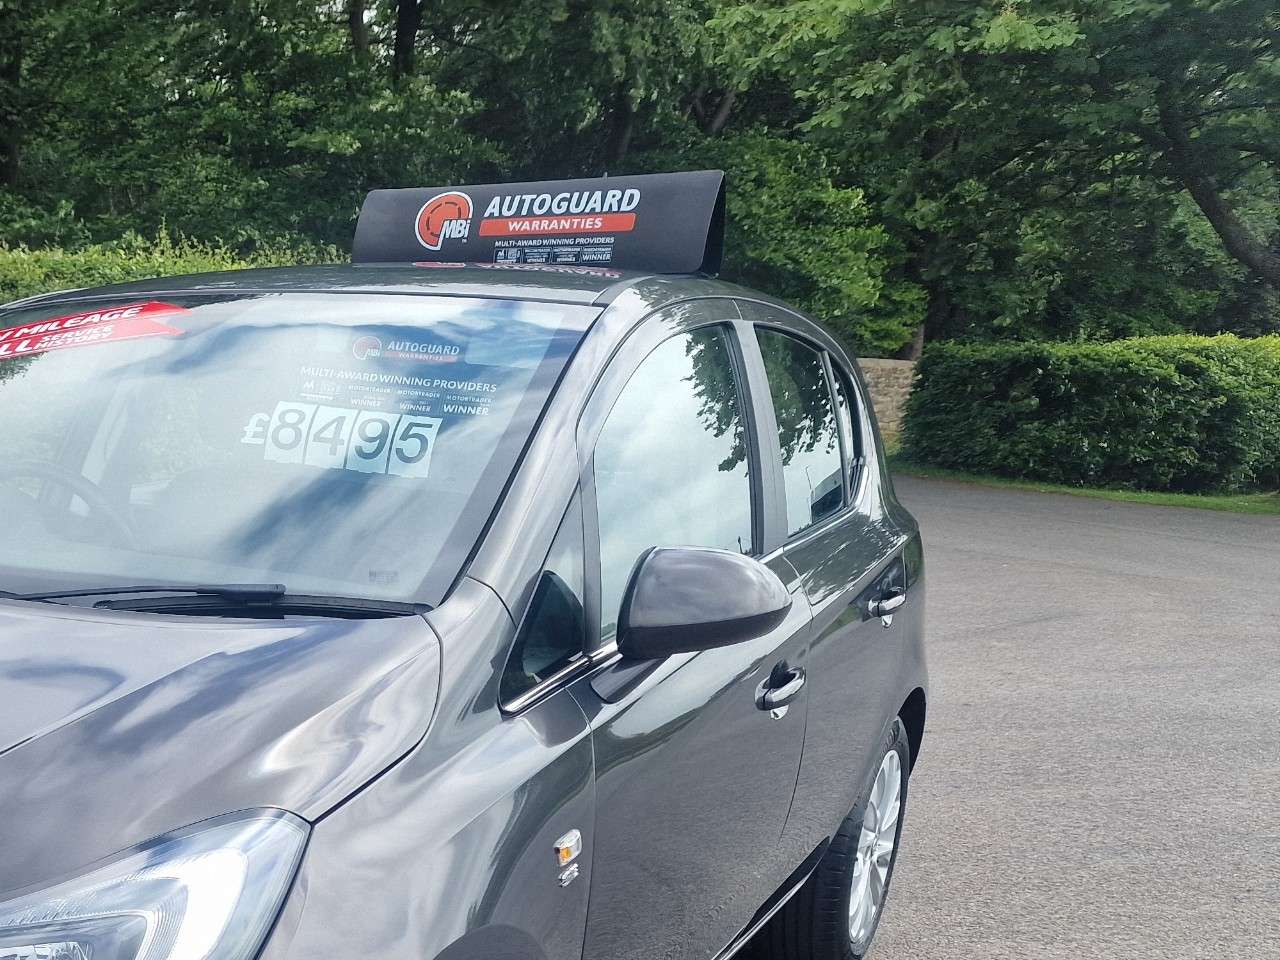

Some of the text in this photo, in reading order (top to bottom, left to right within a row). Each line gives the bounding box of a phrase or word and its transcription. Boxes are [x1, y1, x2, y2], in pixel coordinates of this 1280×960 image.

[484, 189, 640, 217] AUTOGUARD
[508, 217, 603, 232] WARRANTIES
[542, 238, 574, 246] WINNING
[575, 237, 615, 245] PROVIDERS
[582, 253, 611, 261] WINNER
[15, 307, 144, 338] MILEAGE
[34, 331, 114, 350] HISTORY
[41, 324, 114, 342] SERVICE
[387, 341, 460, 355] AUTOGUARD
[379, 374, 431, 388] WINNING
[433, 379, 497, 392] PROVIDERS
[400, 403, 432, 412] WINNER
[443, 404, 489, 415] WINNER
